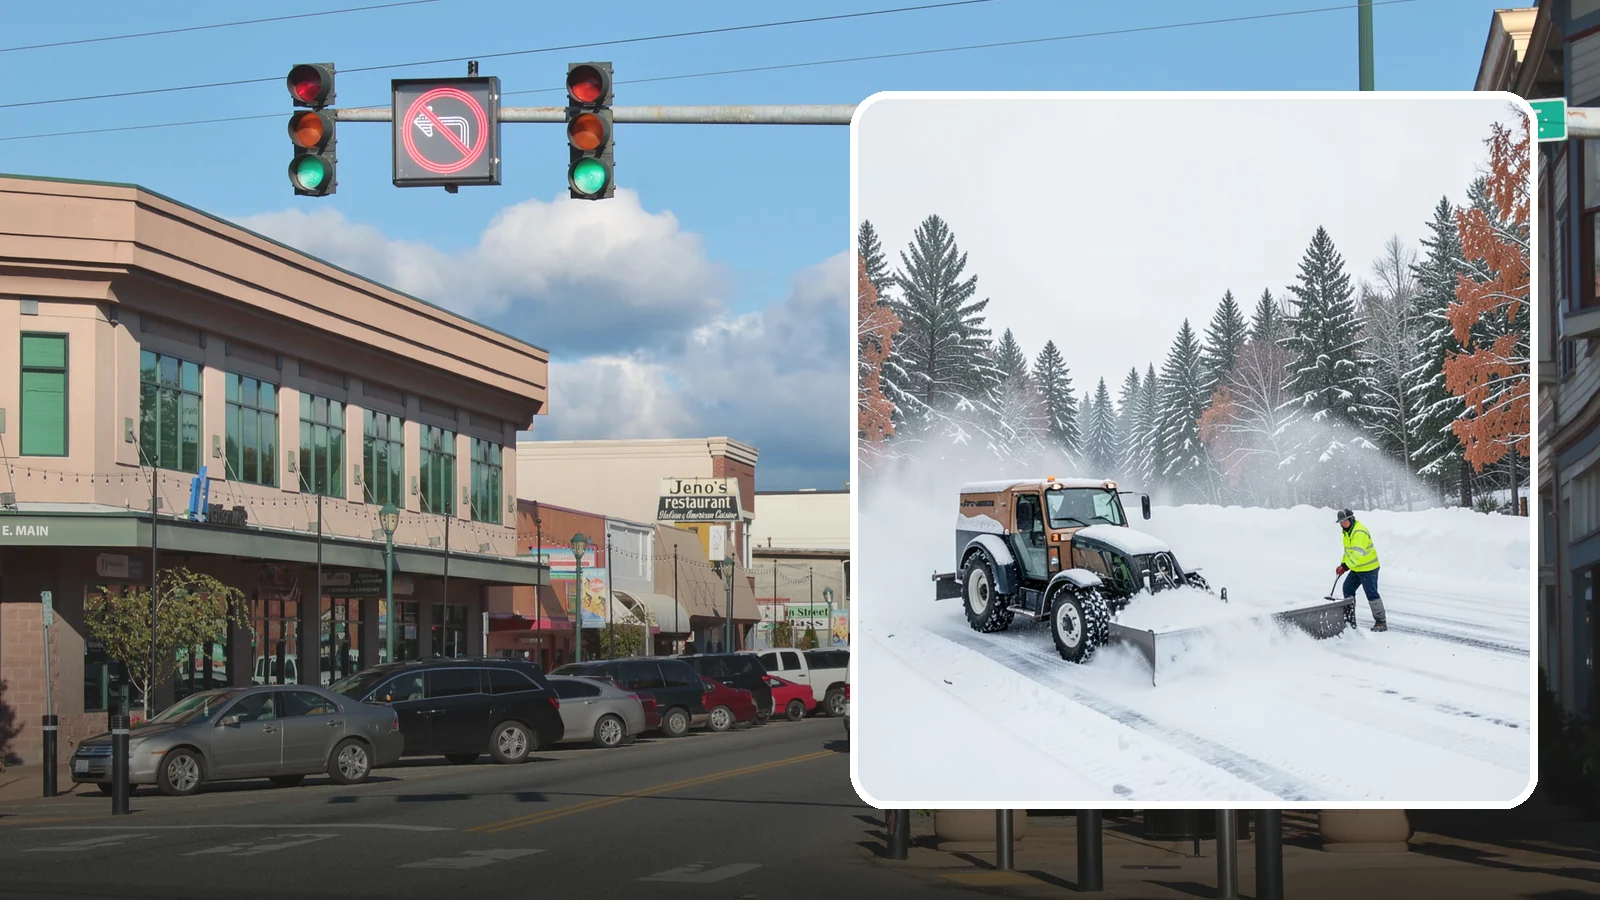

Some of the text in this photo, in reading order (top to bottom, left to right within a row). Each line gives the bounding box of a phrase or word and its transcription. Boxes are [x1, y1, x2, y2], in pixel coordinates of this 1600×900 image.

[669, 479, 728, 495] Jeno's
[665, 496, 731, 509] restaurant
[658, 509, 681, 520] Italian
[685, 509, 715, 519] American
[715, 509, 738, 519] Cuisine
[2, 525, 49, 536] E. MAIN
[797, 607, 829, 617] Street
